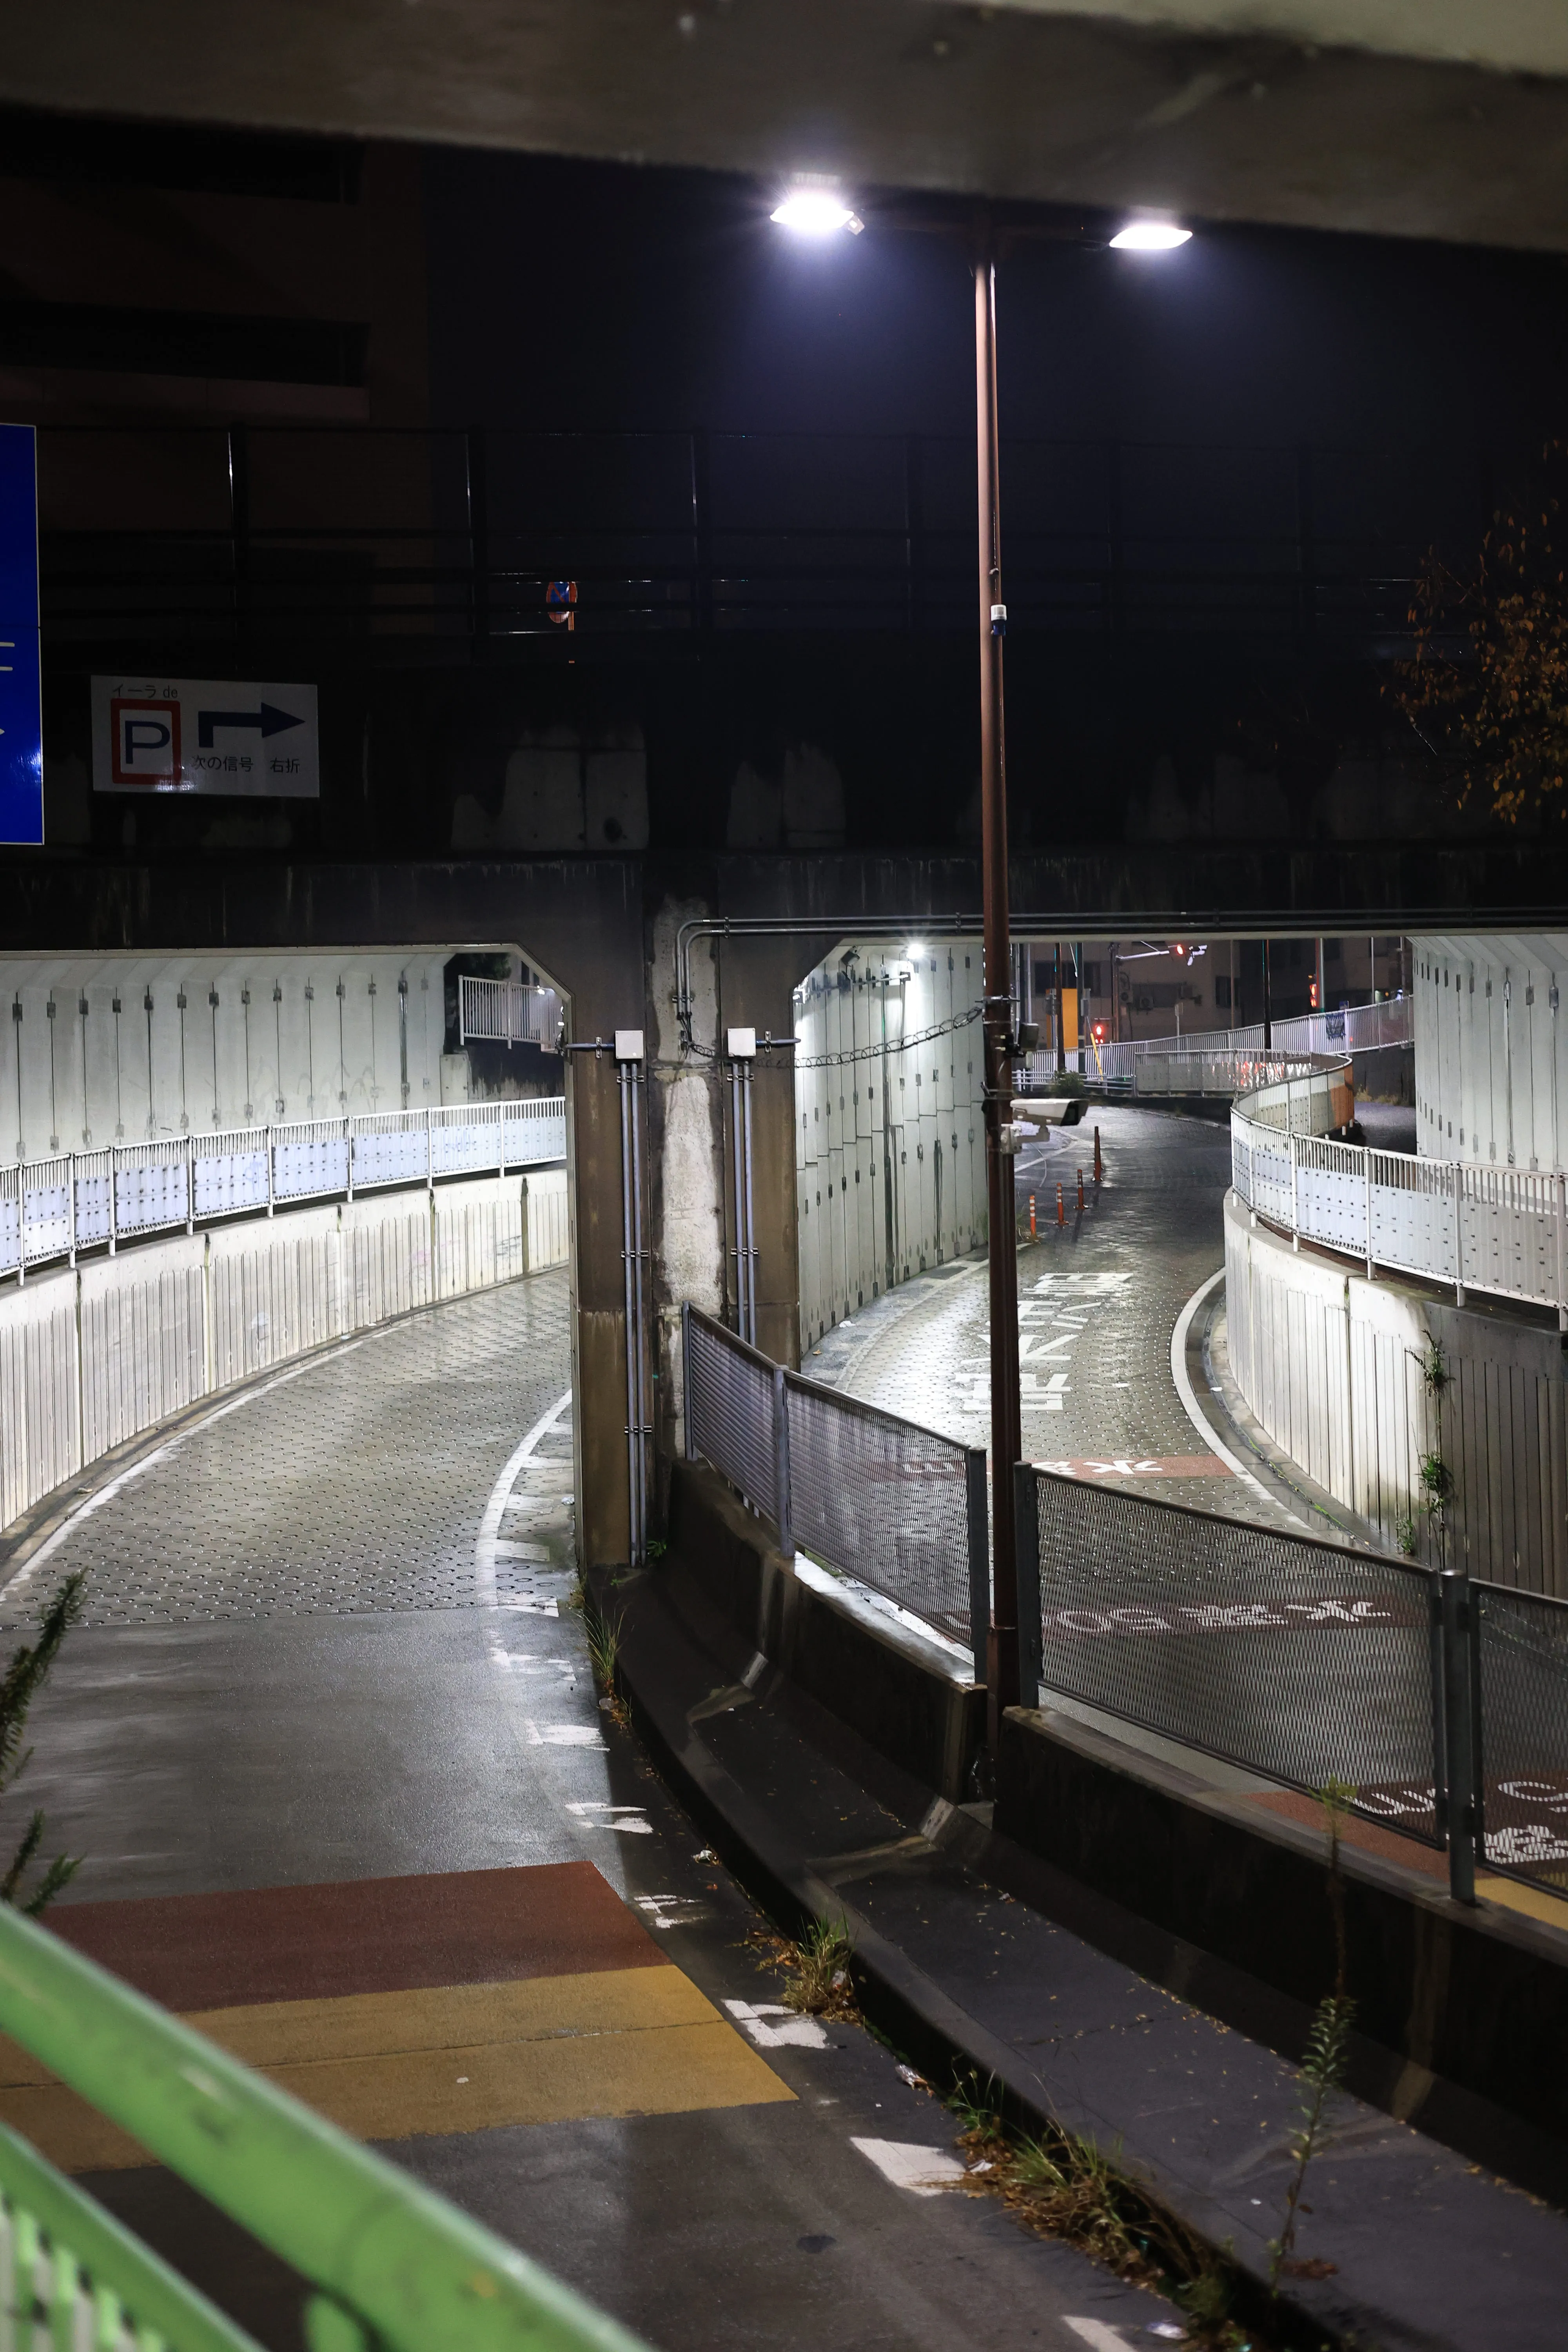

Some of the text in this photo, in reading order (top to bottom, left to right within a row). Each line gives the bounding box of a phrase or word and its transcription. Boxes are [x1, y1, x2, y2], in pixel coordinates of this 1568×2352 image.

[112, 684, 178, 698] イーラ de
[125, 720, 171, 764] P
[192, 755, 301, 774] 次の信号 右折
